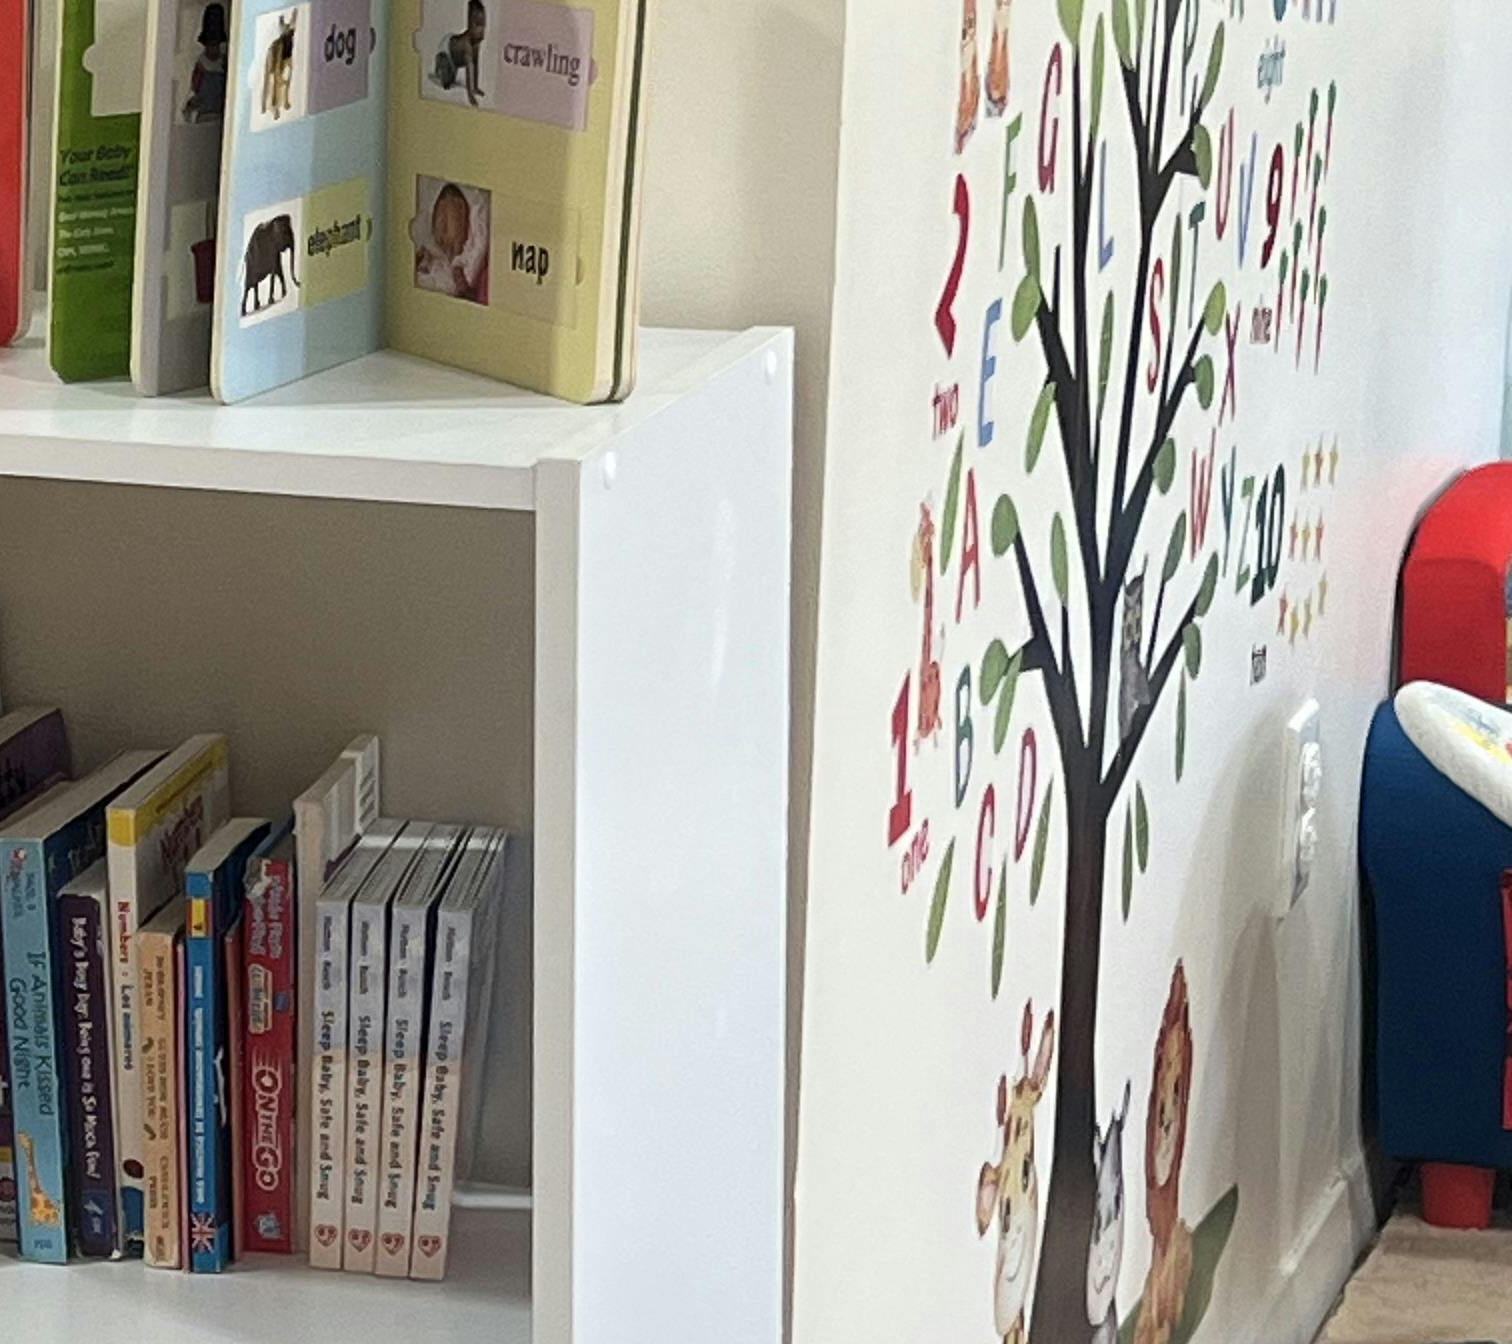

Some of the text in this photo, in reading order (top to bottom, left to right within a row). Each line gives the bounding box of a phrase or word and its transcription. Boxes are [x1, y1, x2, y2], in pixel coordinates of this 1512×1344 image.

[324, 24, 357, 66] dog
[502, 39, 581, 86] crawling
[307, 217, 361, 258] elephant
[999, 113, 1022, 272] F
[1099, 139, 1114, 273] L
[1216, 107, 1234, 240] U
[1238, 132, 1257, 269] V
[1261, 143, 1282, 269] 9
[511, 239, 550, 287] nap
[935, 174, 969, 358] 2
[1148, 258, 1165, 394] S
[1188, 201, 1205, 330] T
[978, 298, 1002, 447] E
[1219, 302, 1240, 426] X
[957, 469, 979, 623] A
[1192, 428, 1216, 562] W
[1221, 446, 1236, 578] Y
[1235, 476, 1255, 594] Z
[1250, 463, 1285, 607] 10
[889, 669, 911, 846] 1
[956, 664, 973, 809] B
[1016, 728, 1036, 862] D
[902, 819, 929, 895] one
[976, 783, 994, 922] C
[8, 976, 31, 1090] Good Night
[27, 951, 55, 1116] If Animals Kissed
[319, 1010, 335, 1161] Sleep Safe and
[354, 1015, 373, 1165] Sleep Safe and
[388, 1018, 410, 1170] Sleep Safe and
[427, 1021, 454, 1172] Sleep Safe and
